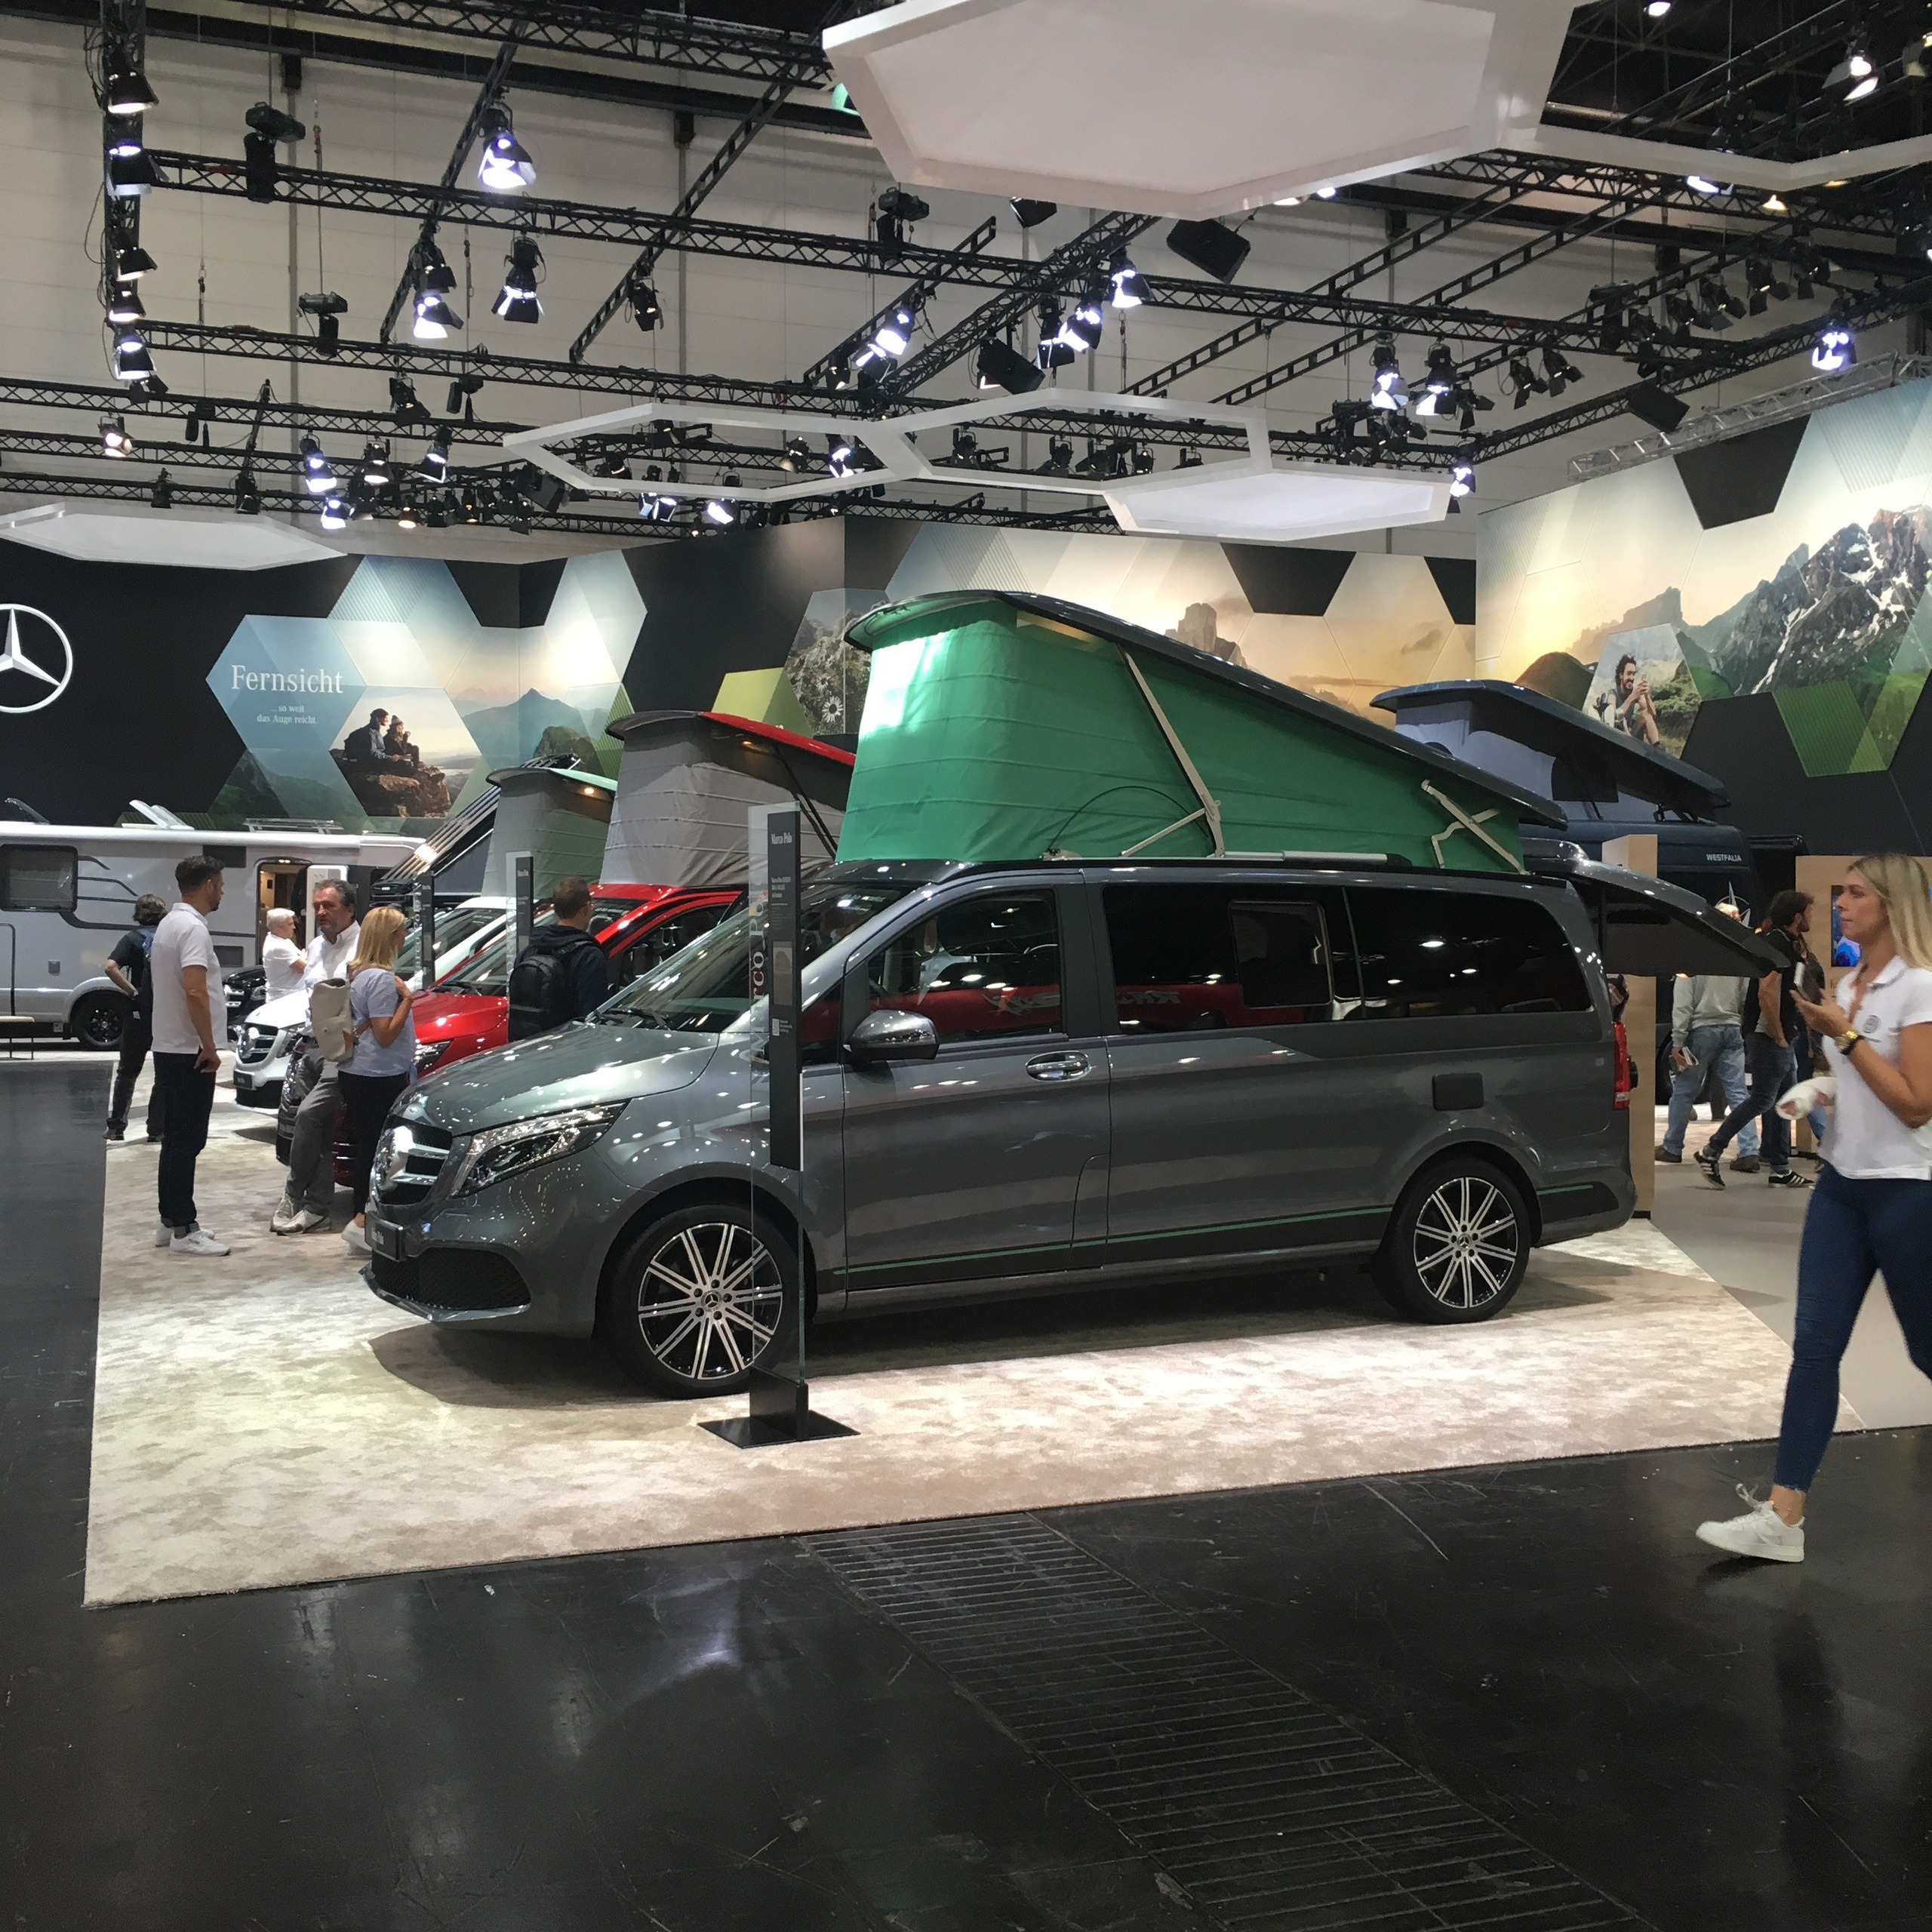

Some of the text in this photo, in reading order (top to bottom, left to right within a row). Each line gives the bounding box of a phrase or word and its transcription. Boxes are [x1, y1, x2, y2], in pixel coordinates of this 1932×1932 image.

[231, 665, 343, 694] Fernsicht
[288, 705, 305, 713] weit
[257, 714, 318, 724] das Auge reicht.
[1706, 853, 1742, 862] WESTFALIA
